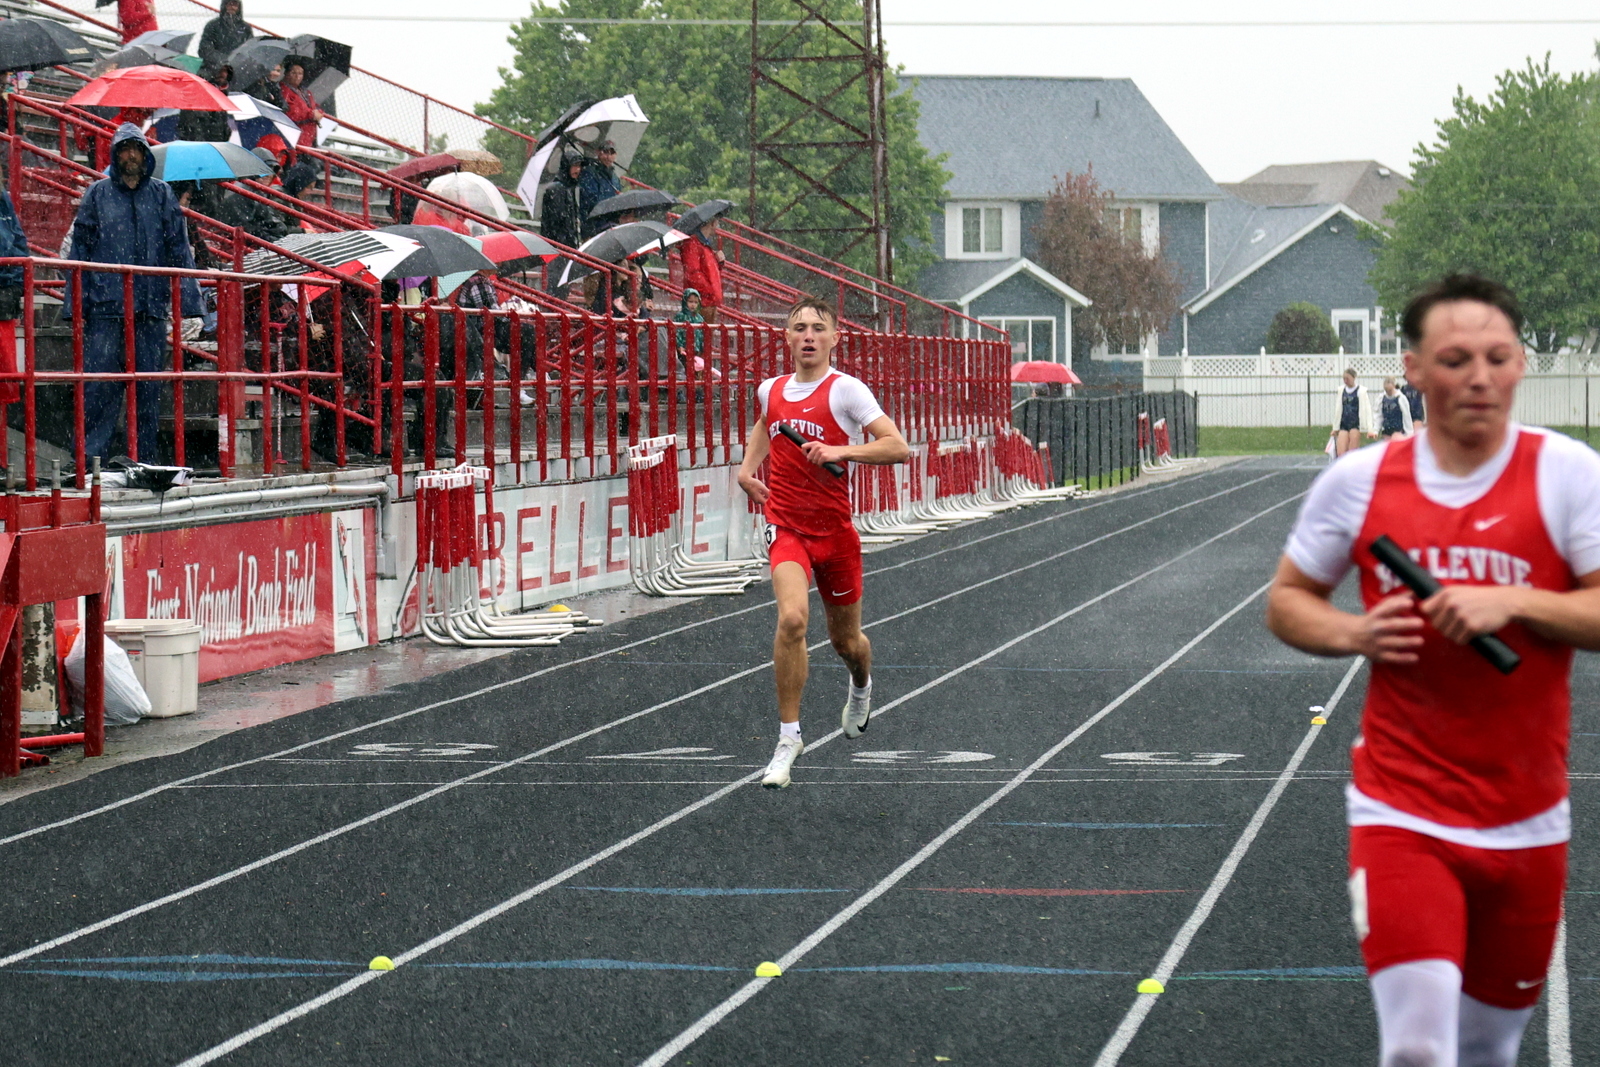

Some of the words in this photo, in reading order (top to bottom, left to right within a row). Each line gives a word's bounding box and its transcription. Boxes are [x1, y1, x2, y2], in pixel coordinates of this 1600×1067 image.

[769, 419, 825, 440] ELEVUE
[477, 484, 710, 599] BELLEE
[1374, 545, 1533, 594] LEVUE
[184, 551, 244, 646] National
[245, 547, 282, 636] Bank
[285, 541, 317, 628] Field
